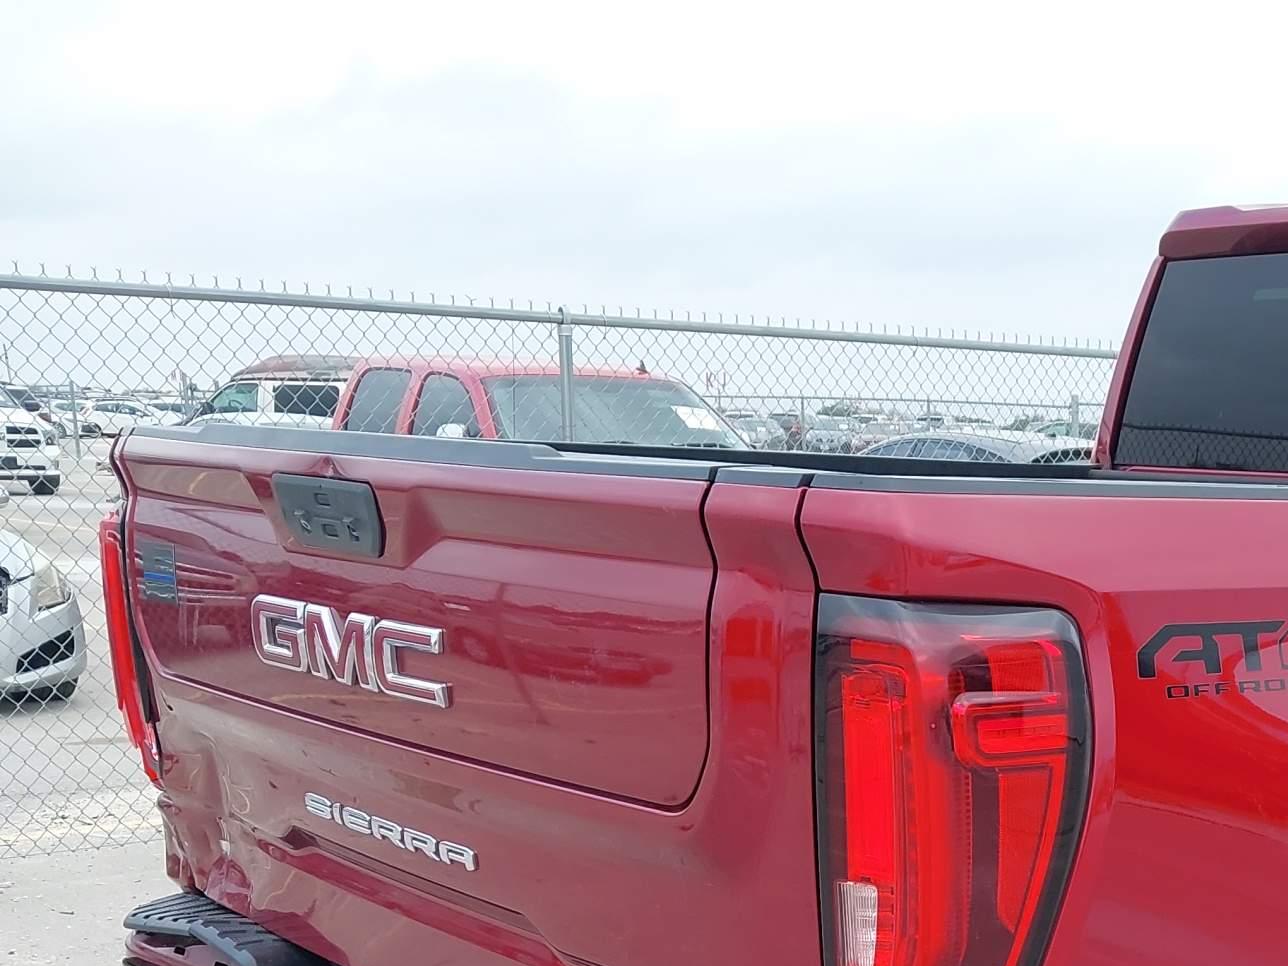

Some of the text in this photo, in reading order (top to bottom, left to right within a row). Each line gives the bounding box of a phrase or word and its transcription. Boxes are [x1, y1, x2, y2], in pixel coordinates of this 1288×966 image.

[251, 594, 452, 708] GMC
[1166, 682, 1233, 699] OFF
[303, 792, 478, 871] SIERRA
